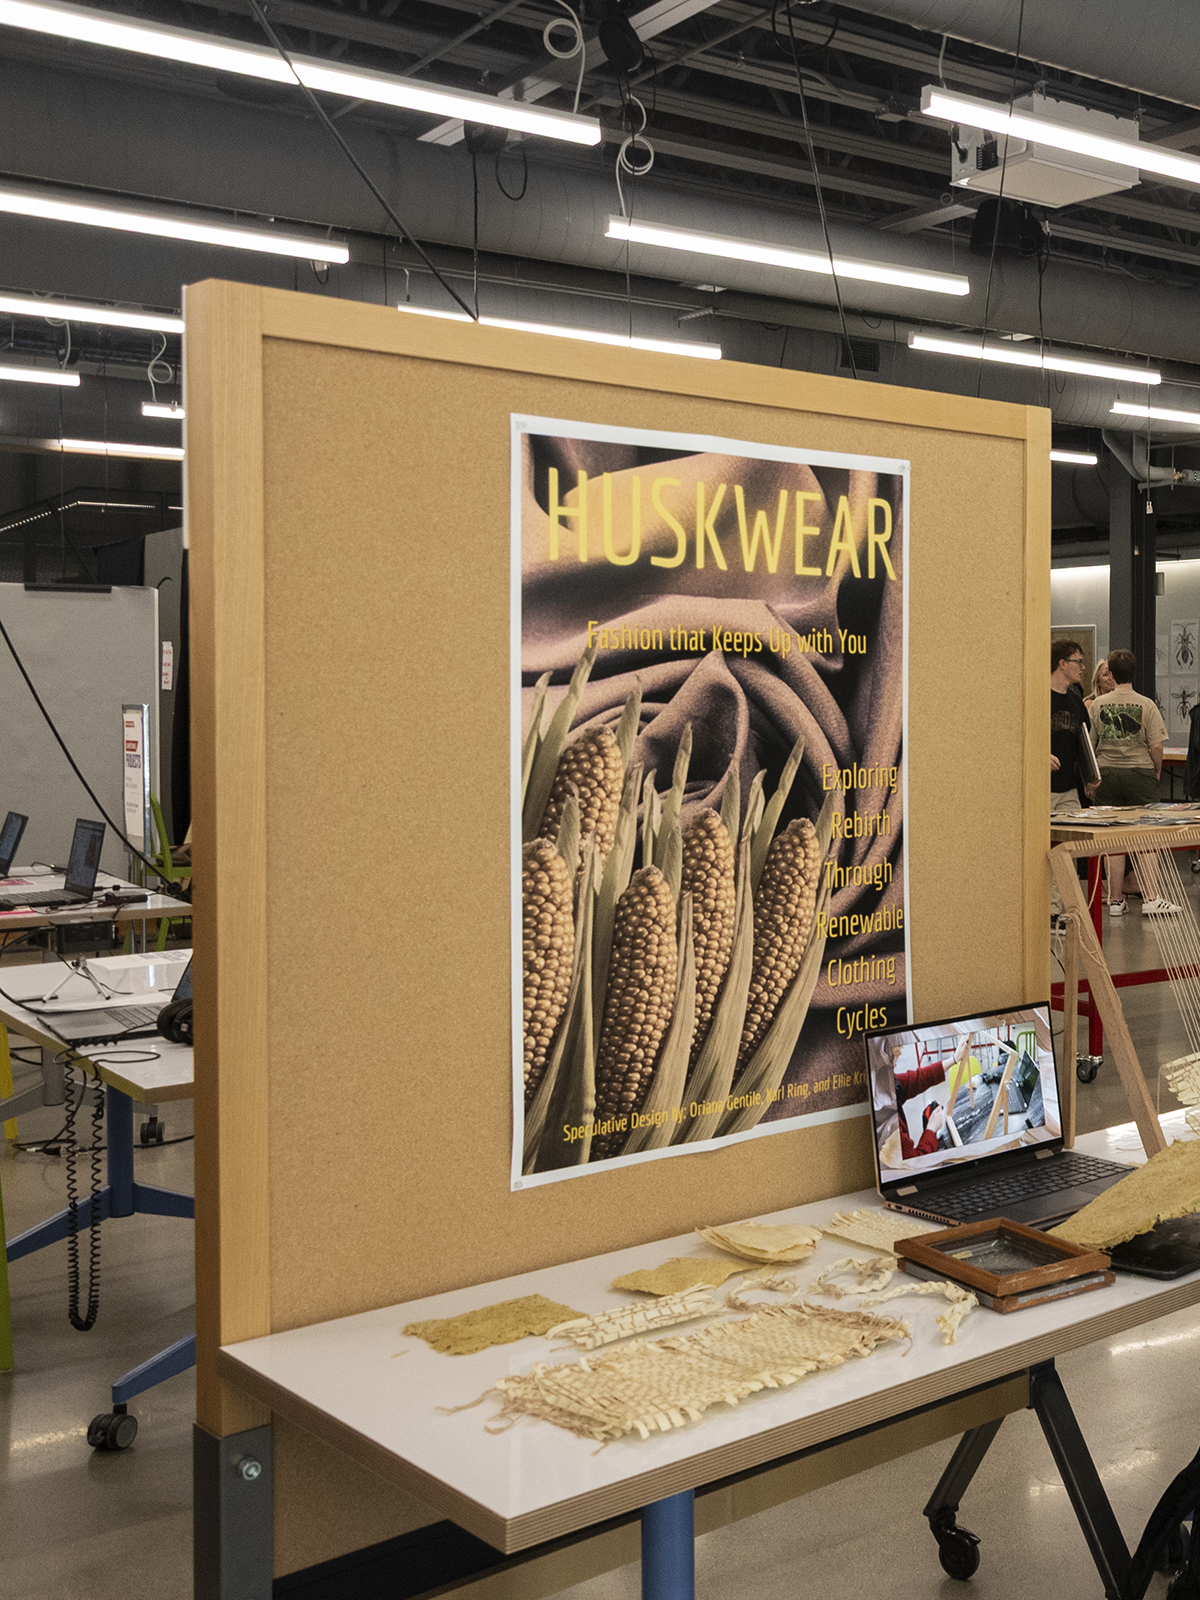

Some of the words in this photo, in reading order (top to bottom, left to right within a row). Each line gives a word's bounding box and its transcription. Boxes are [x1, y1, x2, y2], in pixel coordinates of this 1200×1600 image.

[547, 466, 897, 581] HUSKWEAR
[588, 620, 663, 651] Fashion
[670, 624, 706, 652] that
[711, 625, 762, 658] Keeps
[769, 628, 791, 659] Up
[798, 627, 833, 655] with
[838, 629, 867, 655] You
[822, 762, 898, 796] Exploring
[831, 808, 891, 839] Rebirth
[823, 857, 893, 891] Through
[816, 903, 904, 940] Renewable
[827, 954, 896, 987] Clothing
[836, 1002, 887, 1039] Cycles
[562, 1116, 628, 1144] Speculative
[631, 1109, 669, 1129] Design
[671, 1106, 687, 1124] by:
[690, 1100, 724, 1118] Oriana
[813, 1076, 830, 1094] and
[832, 1072, 852, 1090] Ellie
